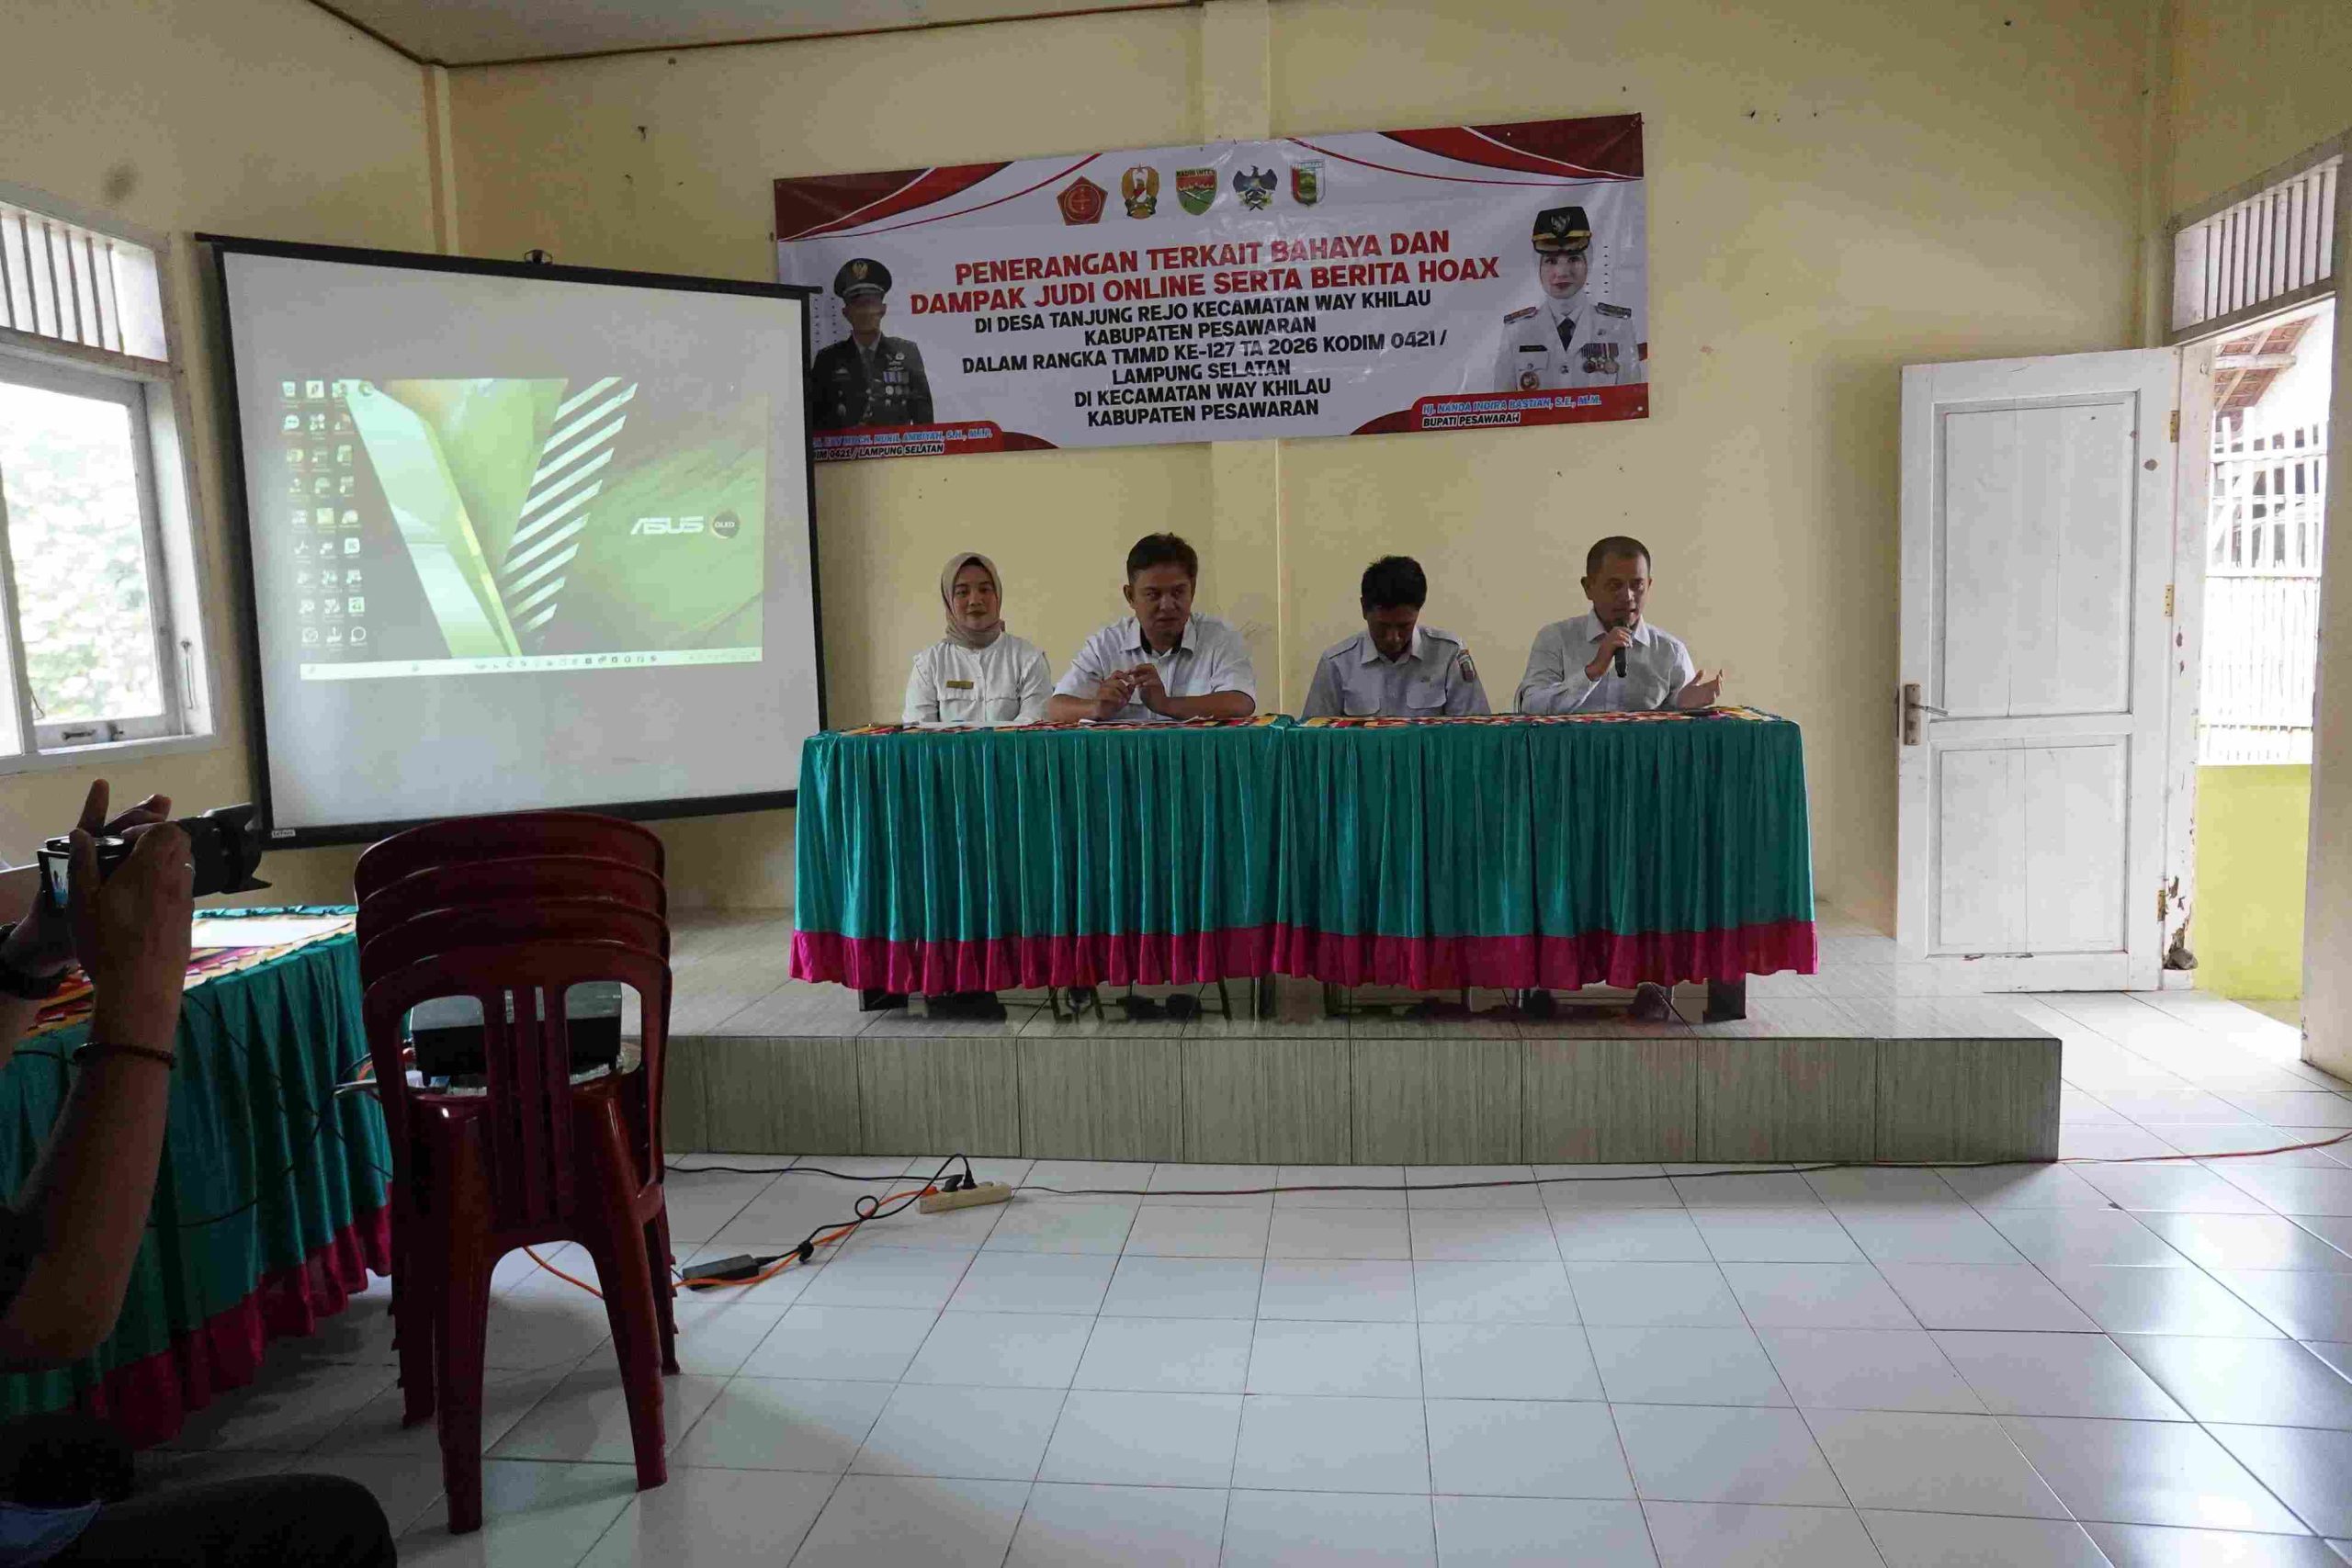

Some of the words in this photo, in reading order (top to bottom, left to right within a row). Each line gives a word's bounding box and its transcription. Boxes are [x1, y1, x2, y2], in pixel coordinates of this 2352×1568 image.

[956, 250, 1137, 286] PENERANGAN
[1146, 241, 1264, 271] TERKAIT
[1271, 234, 1383, 262] BAHAYA
[1390, 230, 1449, 255] DAN
[910, 287, 1027, 315] DAMPAK
[1034, 282, 1096, 307] JUDI
[1102, 274, 1206, 302] ONLINE
[1214, 267, 1303, 294] SERTA
[1310, 262, 1410, 289] BERITA
[1419, 256, 1500, 283] HOAX
[975, 317, 992, 333] DI
[997, 313, 1046, 333] DESA
[1048, 307, 1133, 329] TANJUNG
[1137, 303, 1188, 322] REJO
[1193, 296, 1309, 319] KECAMATAN
[1315, 293, 1356, 311] WAY
[1362, 289, 1431, 309] KHILAU
[1085, 324, 1193, 346] KABUPATEN
[1198, 316, 1317, 339] PESAWARAN
[962, 355, 1027, 374] DALAM
[1033, 350, 1107, 370] RANGKA
[1111, 346, 1169, 365] TMMD
[1174, 341, 1236, 361] KE-127
[1242, 340, 1263, 356] TA
[1268, 337, 1318, 355] 2026
[1323, 333, 1385, 353] KODIM
[1390, 331, 1435, 349] 0421
[1440, 330, 1448, 346] /
[1112, 364, 1203, 386] LAMPUNG
[1207, 359, 1291, 379] SELATAN
[1074, 390, 1091, 407] DI
[1097, 384, 1211, 406] KECAMATAN
[1216, 381, 1257, 399] WAY
[1262, 378, 1331, 397] KHILAU
[1437, 401, 1471, 412] NANDA
[1473, 400, 1507, 412] INDIRA
[1087, 405, 1195, 427] KABUPATEN
[1201, 399, 1318, 421] PESAWARAN
[1423, 416, 1457, 427] BUPATI
[1458, 412, 1520, 425] PESAWARAN
[858, 446, 903, 457] LAMPUNG
[904, 444, 944, 456] SELATAN
[630, 515, 705, 535] ASUS
